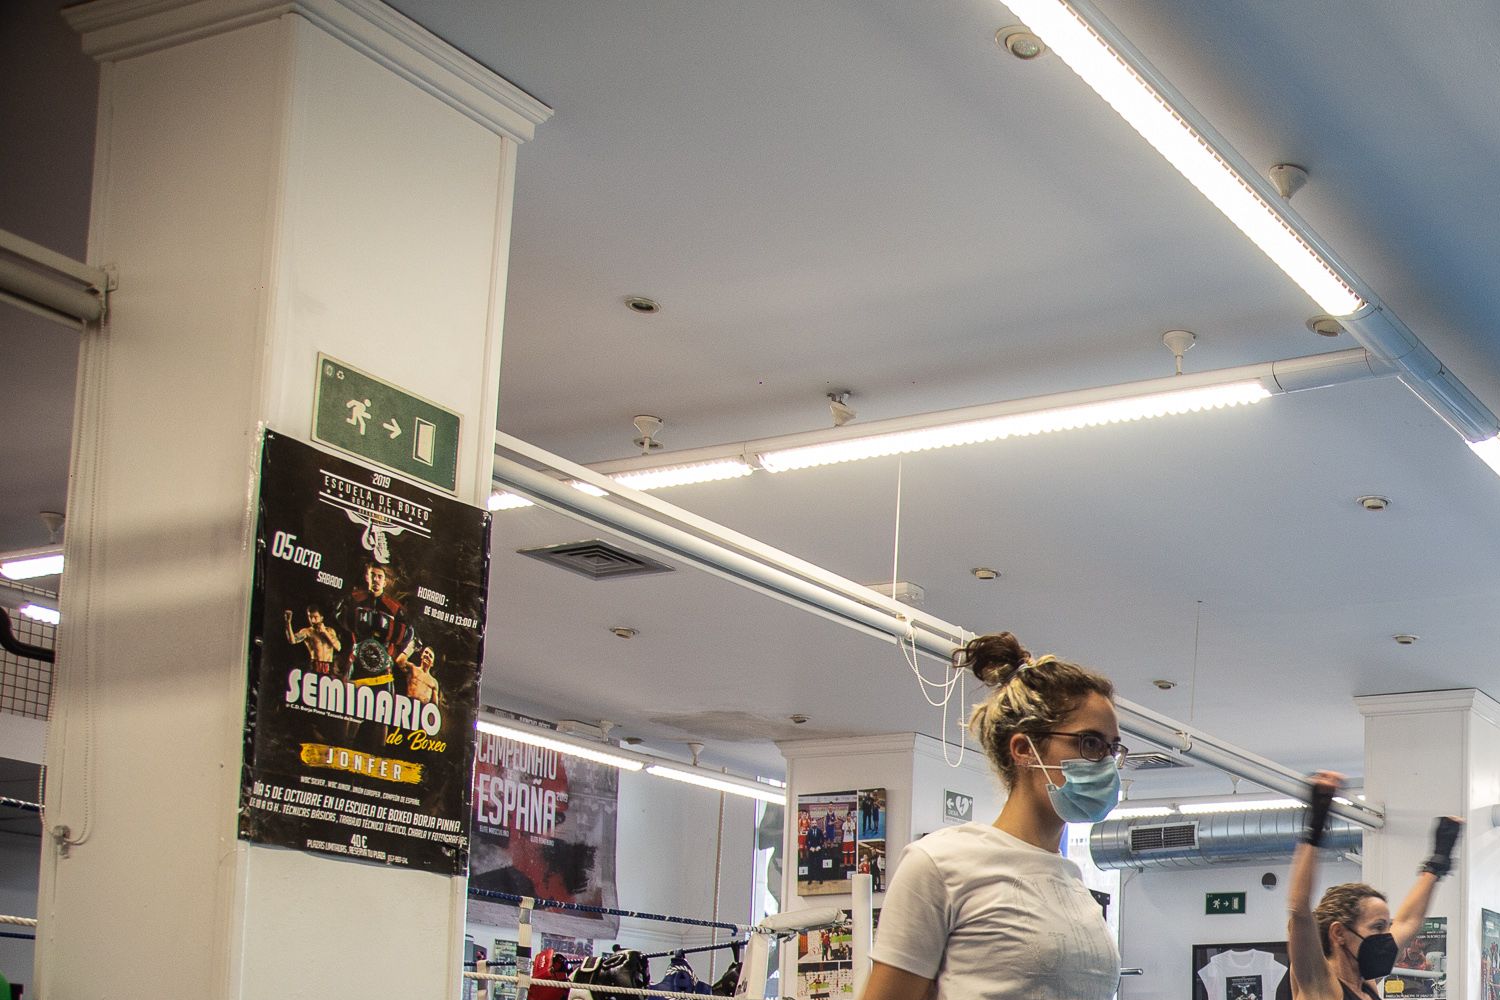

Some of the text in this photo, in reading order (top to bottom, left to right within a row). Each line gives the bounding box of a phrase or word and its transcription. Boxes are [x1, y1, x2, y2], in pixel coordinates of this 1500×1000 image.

[324, 476, 372, 502] ESCUELA
[379, 495, 392, 507] DE
[398, 501, 429, 521] BOXEO
[372, 473, 391, 489] 2019
[352, 496, 375, 510] BORJA
[272, 531, 322, 570] 05 OCTB
[316, 571, 344, 590] SABADO
[423, 605, 432, 616] DE
[449, 614, 455, 624] A
[455, 616, 473, 627] 13:00
[472, 619, 478, 629] H
[286, 668, 442, 736] SEMINARIO
[386, 727, 447, 753] de Boxeo
[327, 748, 402, 780] JONFER
[264, 784, 272, 798] 5
[271, 785, 284, 800] DE
[283, 788, 323, 807] OCTUBRE
[323, 795, 335, 809] EN
[334, 797, 345, 811] LA
[344, 799, 376, 818] ESCUELA
[376, 806, 387, 820] DE
[388, 808, 413, 824] BOXEO
[413, 813, 436, 829] BORJA
[266, 801, 274, 811] 13
[282, 803, 311, 818] TÉCNICAS
[339, 814, 362, 827] TRABAJO
[361, 817, 384, 832] TÉCNICO
[407, 827, 428, 840] CHARLA
[427, 831, 432, 840] Y
[478, 773, 556, 837] ESPAÑA
